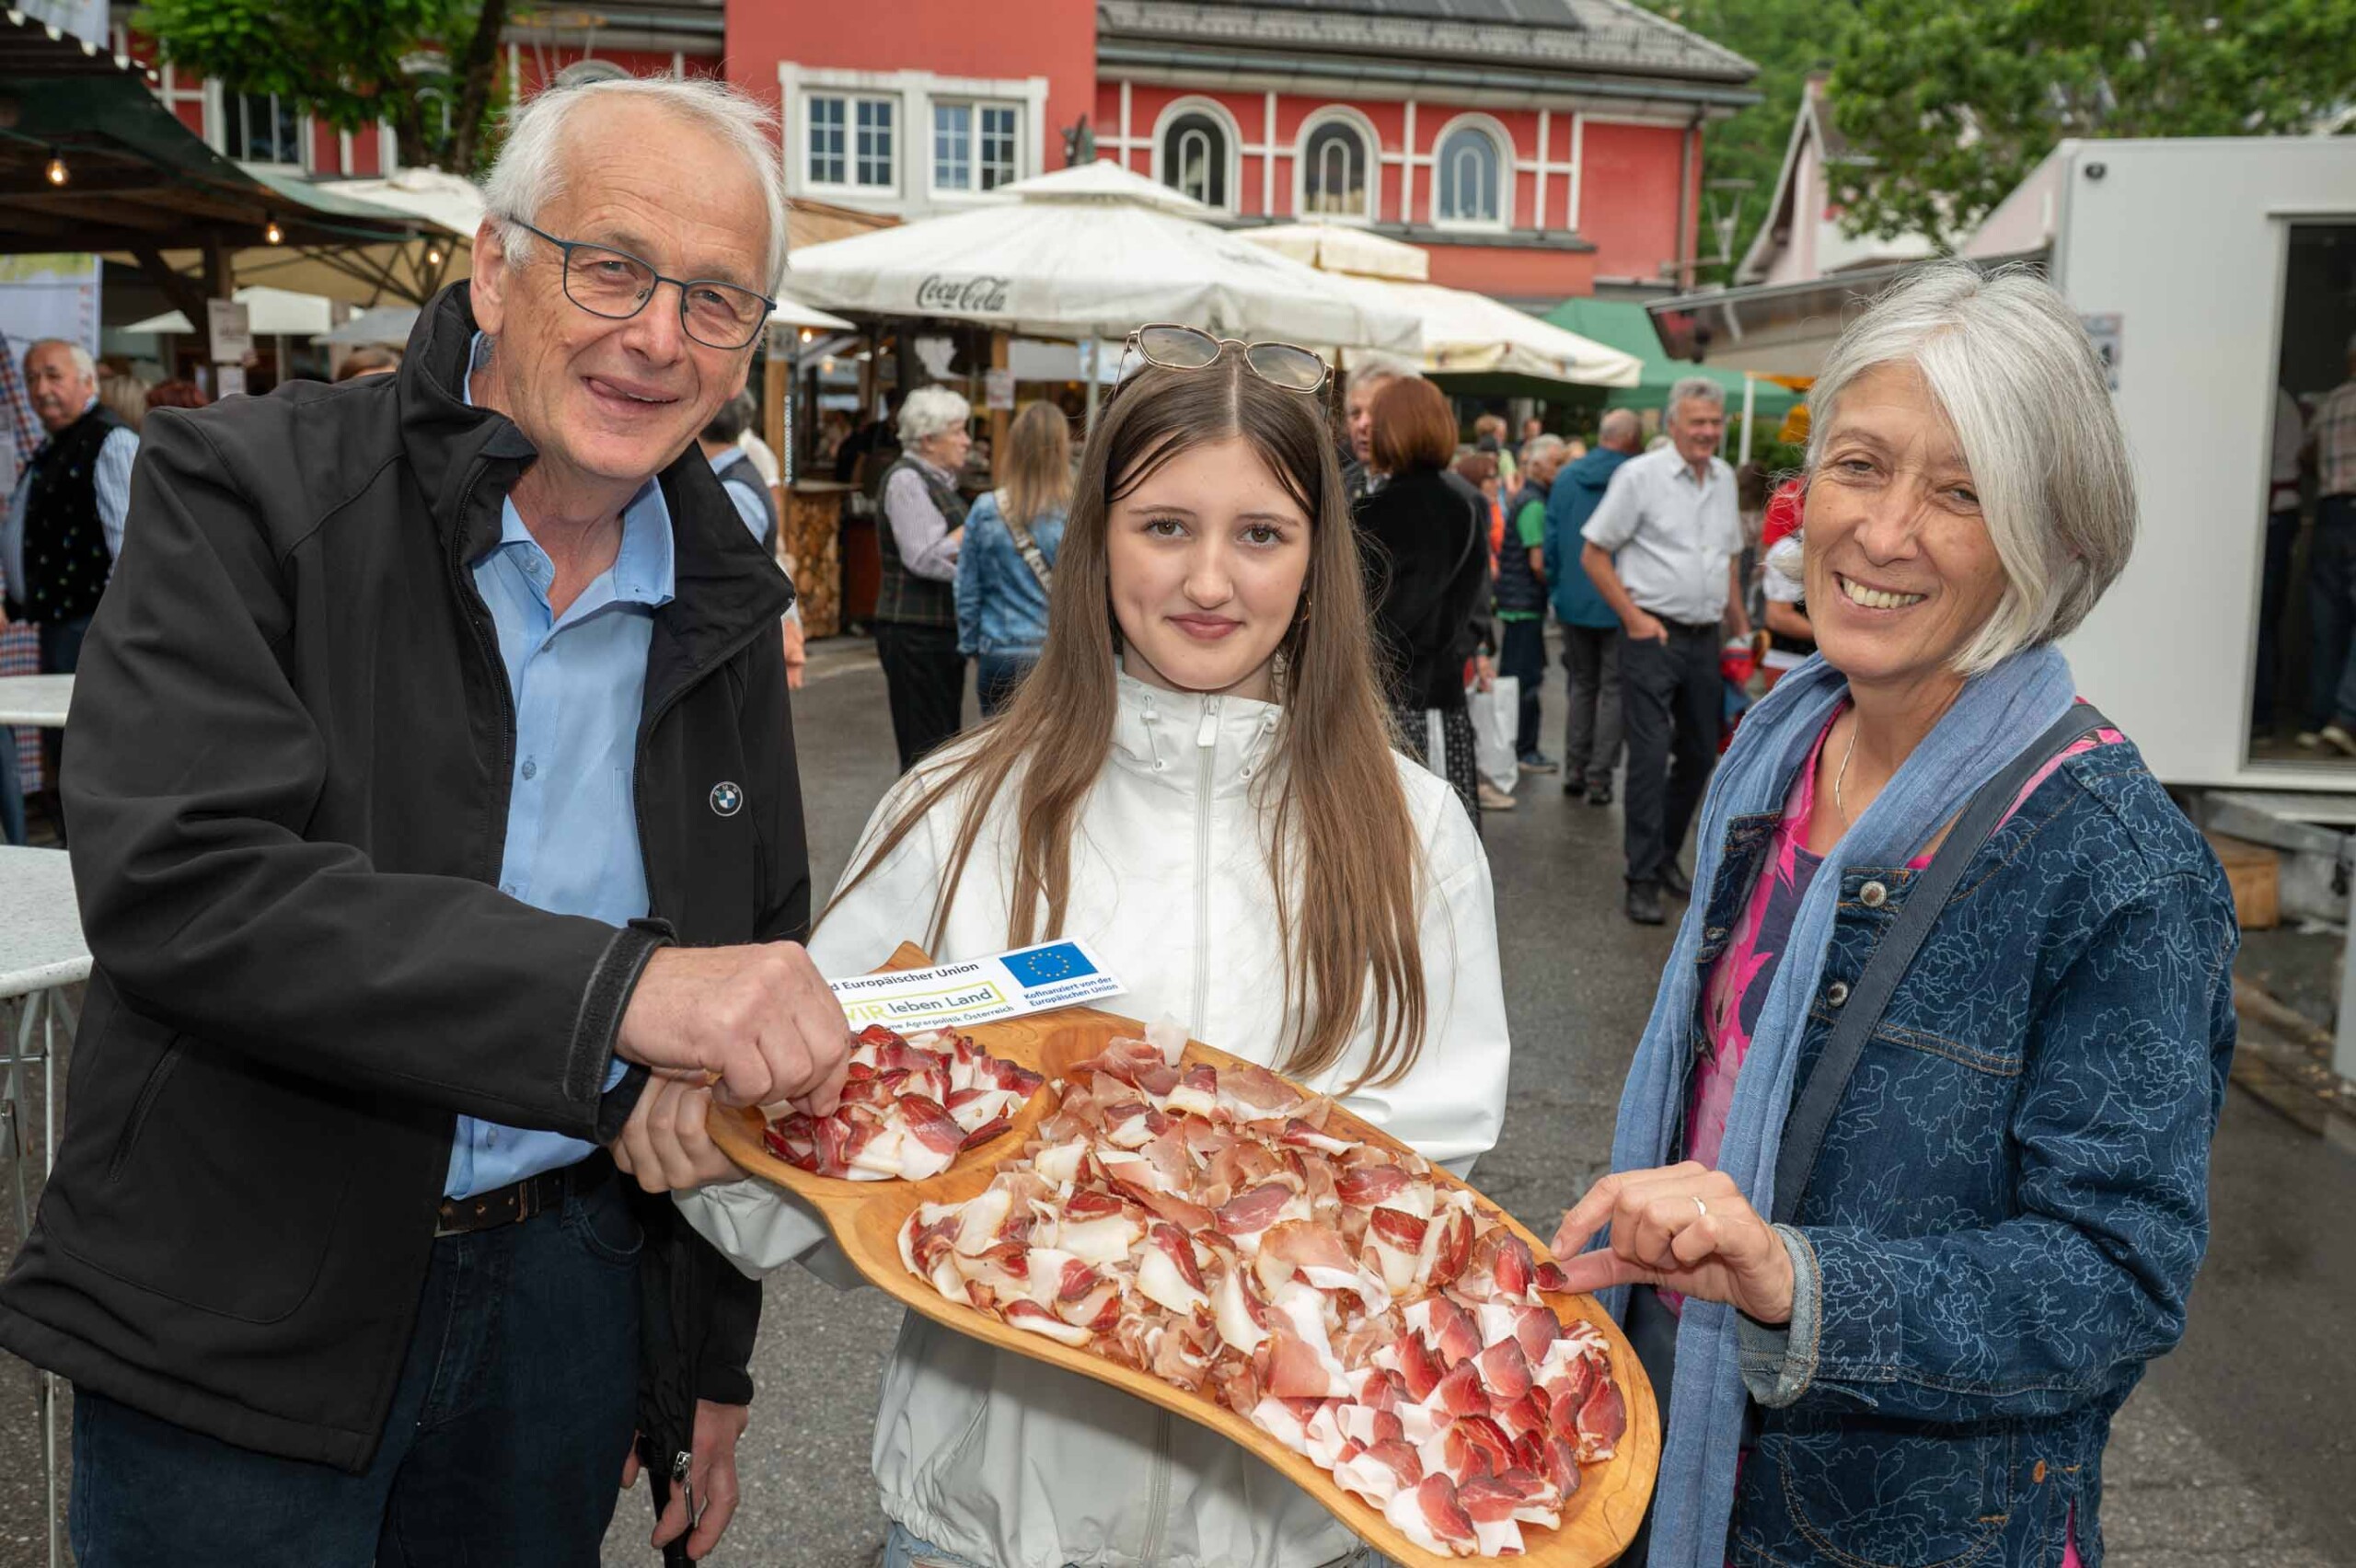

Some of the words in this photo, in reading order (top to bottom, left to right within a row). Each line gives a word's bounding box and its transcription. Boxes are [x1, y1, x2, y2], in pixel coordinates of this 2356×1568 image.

[917, 274, 1011, 311] Coca-Cola
[842, 973, 933, 990] Europäischer
[935, 963, 980, 978] Union
[1024, 983, 1079, 999] Kofinanziert
[1080, 980, 1097, 988] von
[1097, 976, 1112, 985] der
[887, 1001, 943, 1014] leben
[945, 988, 993, 1007] Land
[1029, 990, 1091, 1007] Europäischen
[1091, 984, 1118, 995] Union
[906, 1016, 962, 1029] Agrarpolitik
[964, 1004, 1014, 1020] Österreich
